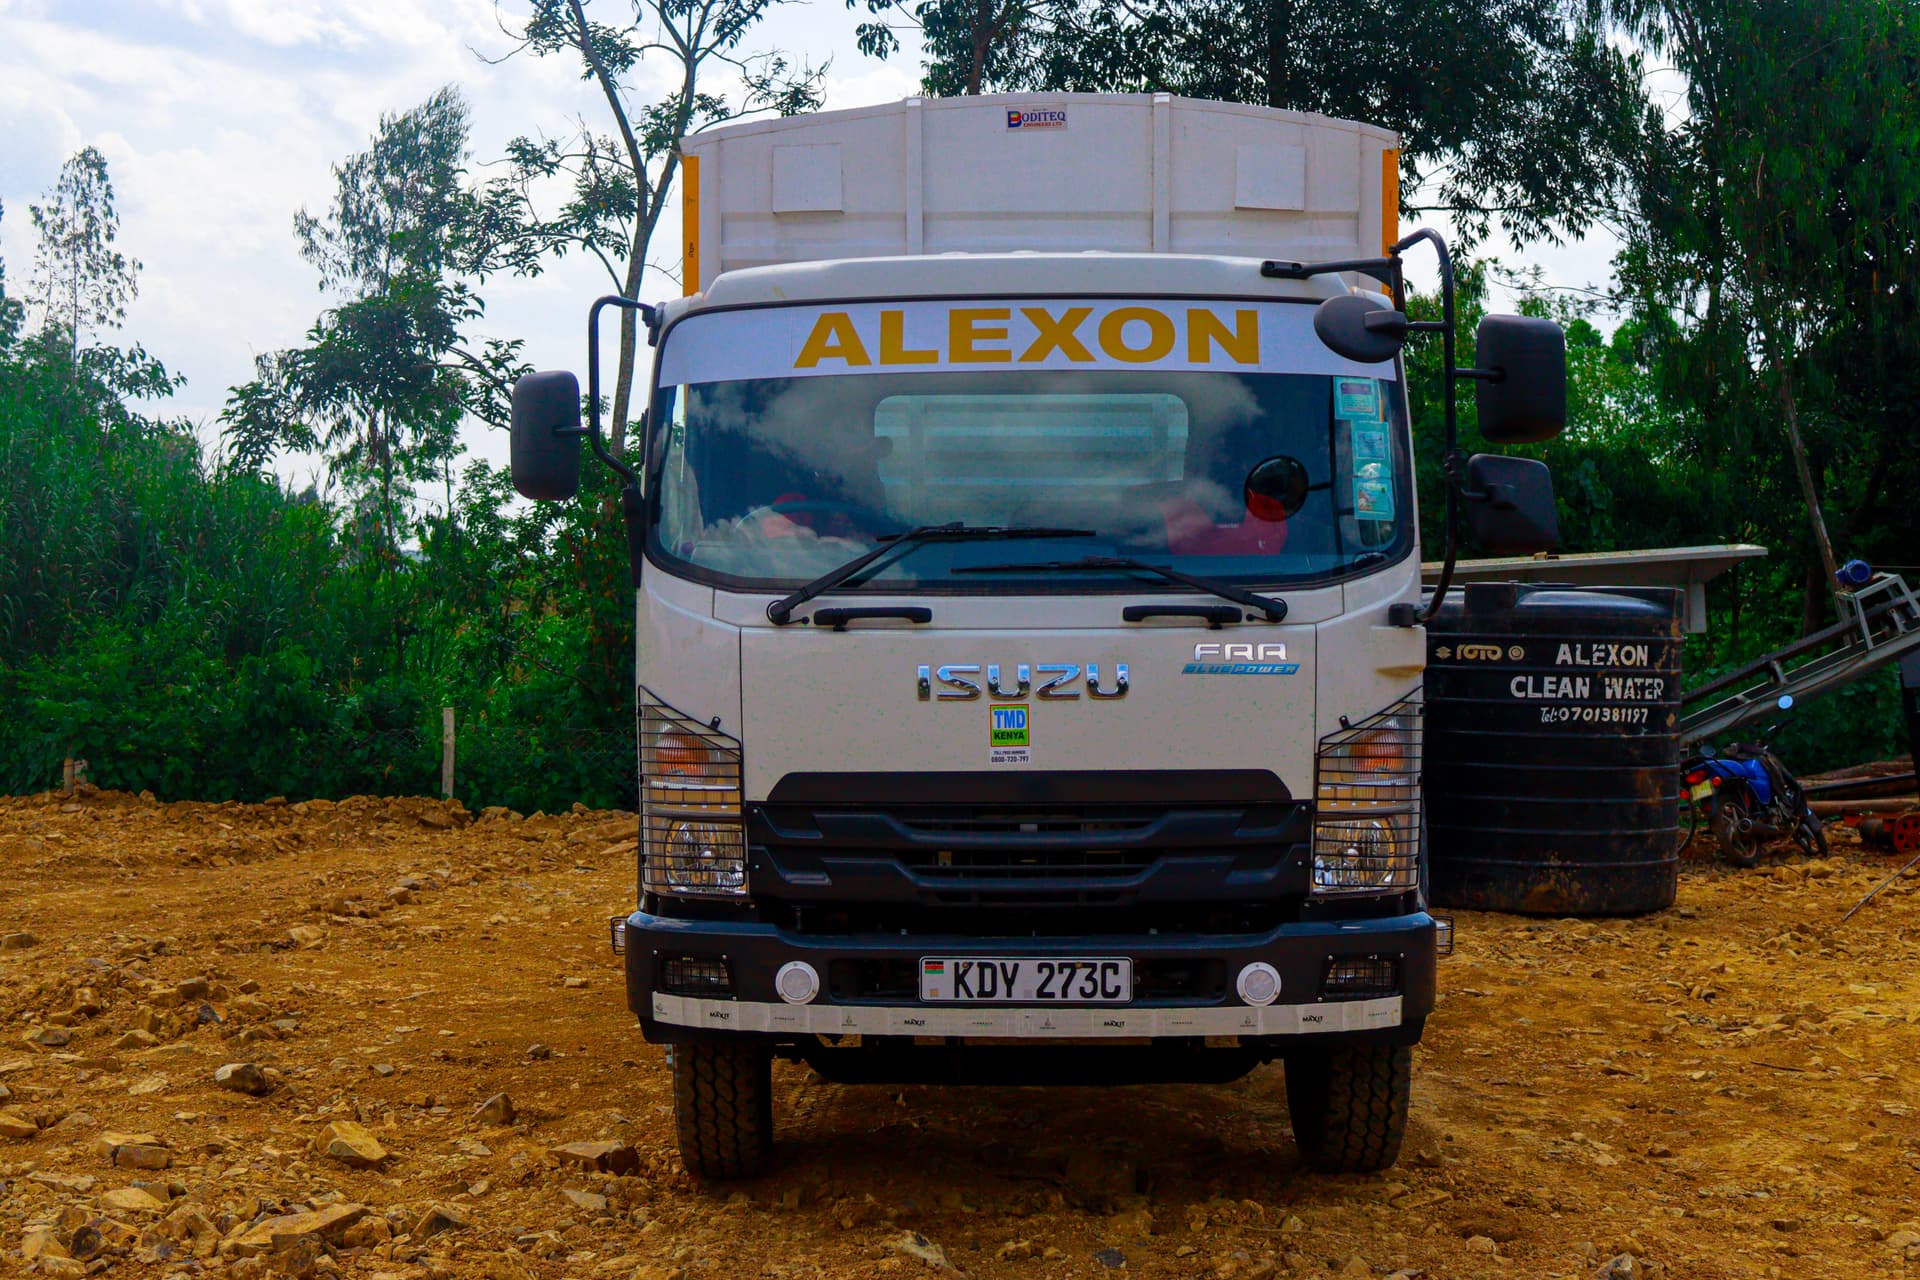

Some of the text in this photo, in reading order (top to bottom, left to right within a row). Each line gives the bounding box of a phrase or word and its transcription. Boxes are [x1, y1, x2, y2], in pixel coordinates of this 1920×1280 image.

[1008, 111, 1066, 128] BODITEQ
[794, 306, 1260, 368] ALEXON
[1555, 643, 1649, 667] ALEXON
[916, 663, 1129, 701] ISUZU
[1510, 675, 1664, 700] CLEAN WATER
[994, 710, 1026, 729] TMD
[994, 731, 1025, 740] KENYA
[953, 961, 1121, 999] KDY 273C
